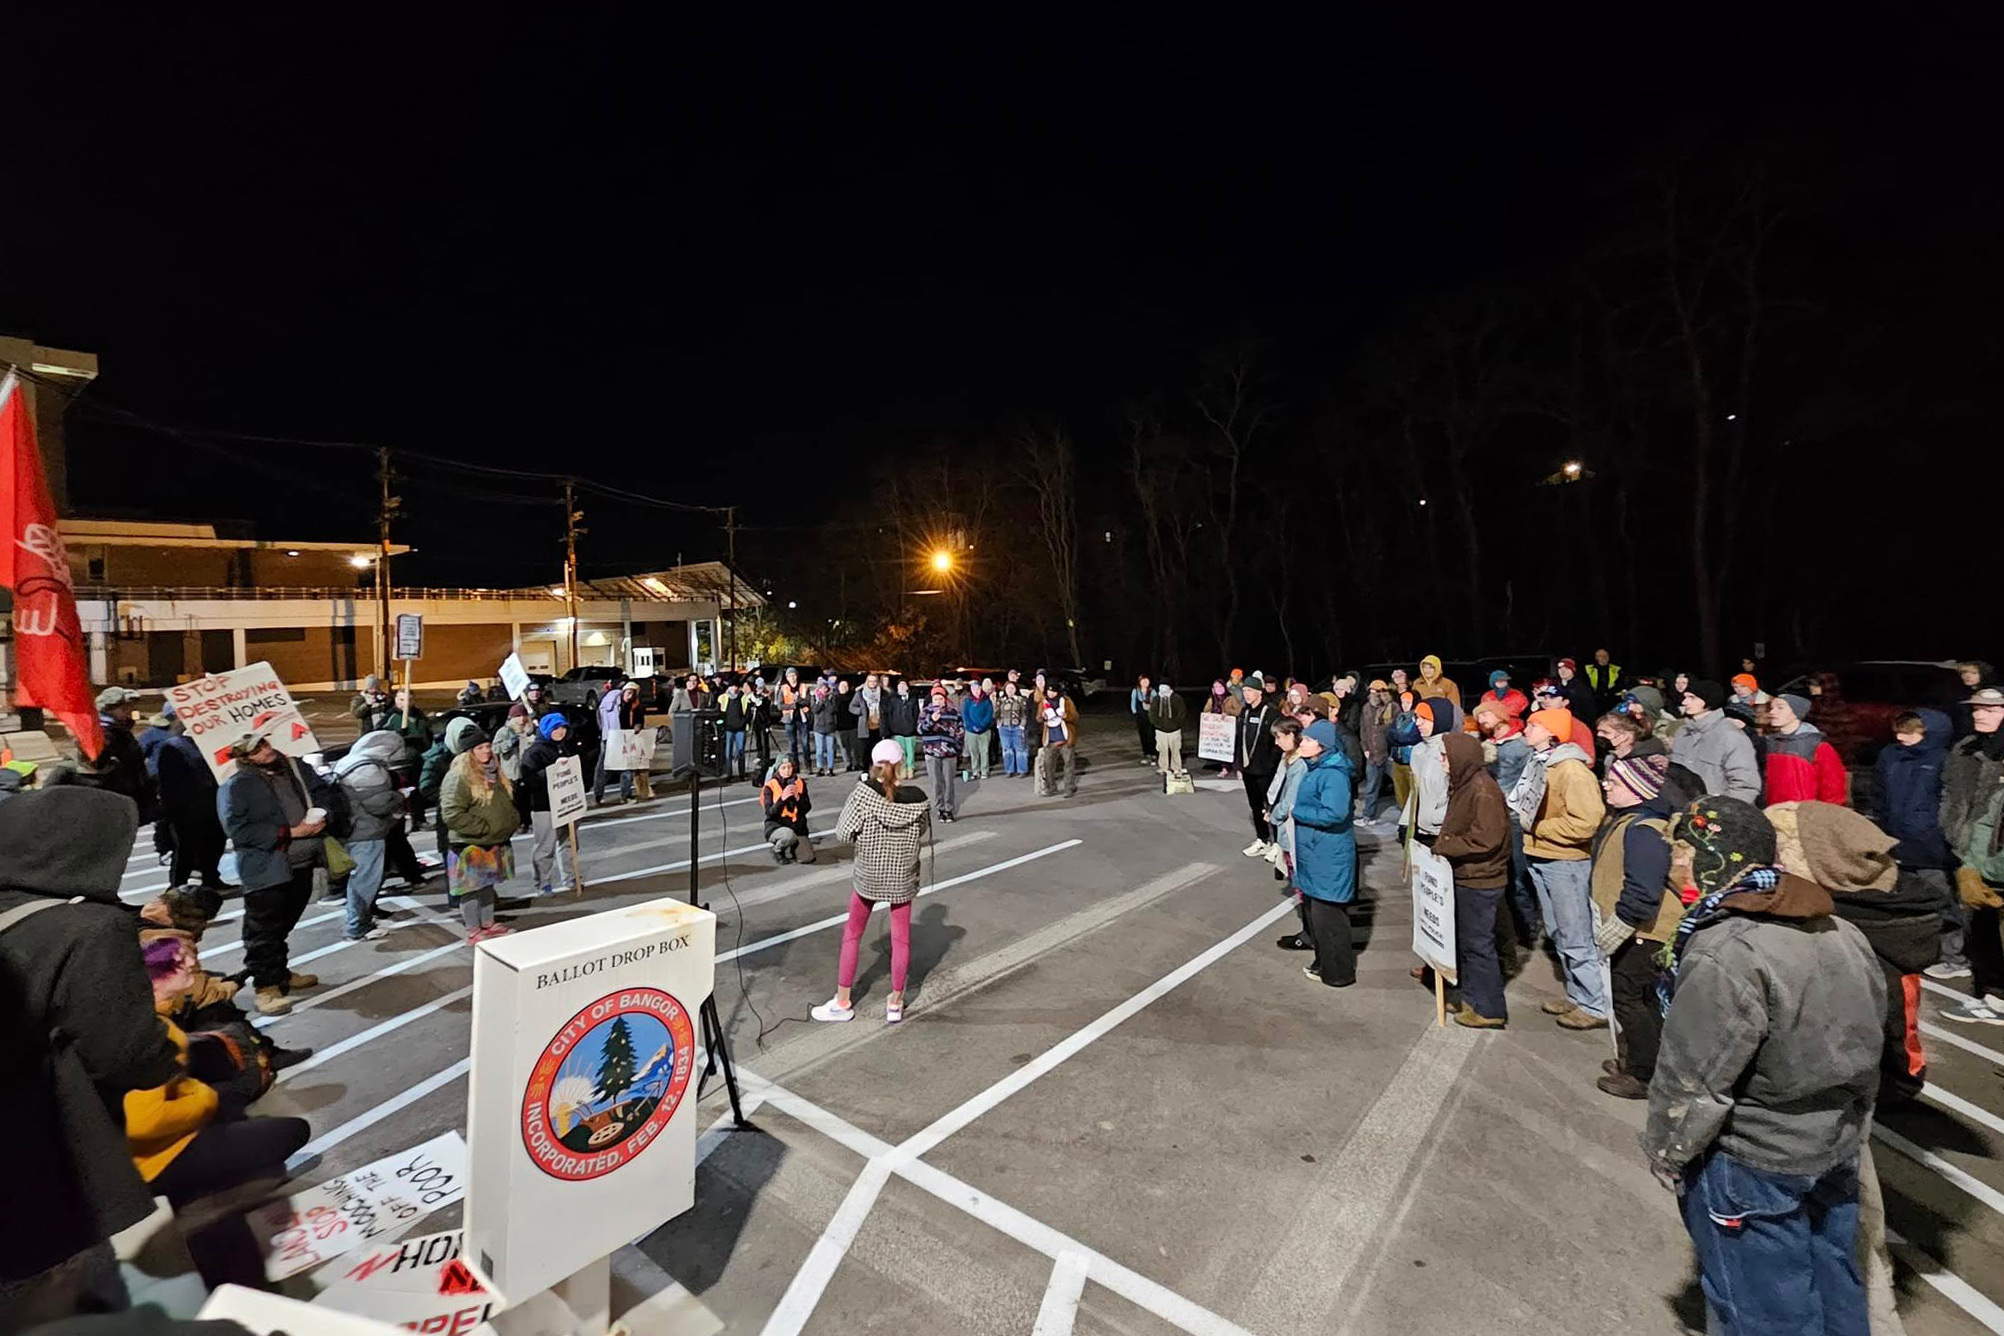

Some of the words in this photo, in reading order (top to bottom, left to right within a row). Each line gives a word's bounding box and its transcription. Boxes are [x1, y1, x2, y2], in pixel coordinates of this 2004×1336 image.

[172, 675, 231, 703] STOP
[176, 681, 279, 719] DESTROYING
[191, 714, 228, 735] OUR
[227, 693, 287, 723] HOMES
[560, 792, 578, 805] NEEDS
[1423, 906, 1440, 927] NEEDS
[536, 957, 607, 990] BALLOT
[611, 944, 655, 969] DROP
[659, 934, 691, 955] BOX
[551, 1019, 587, 1057] CITY
[591, 999, 614, 1020] OF
[619, 993, 680, 1019] BANGOR
[674, 1045, 689, 1084] 1834
[354, 1171, 388, 1192] THE
[395, 1153, 463, 1205] POOR
[305, 1205, 348, 1240] STOP
[322, 1179, 388, 1239] MOOCHING
[380, 1196, 418, 1220] OFF
